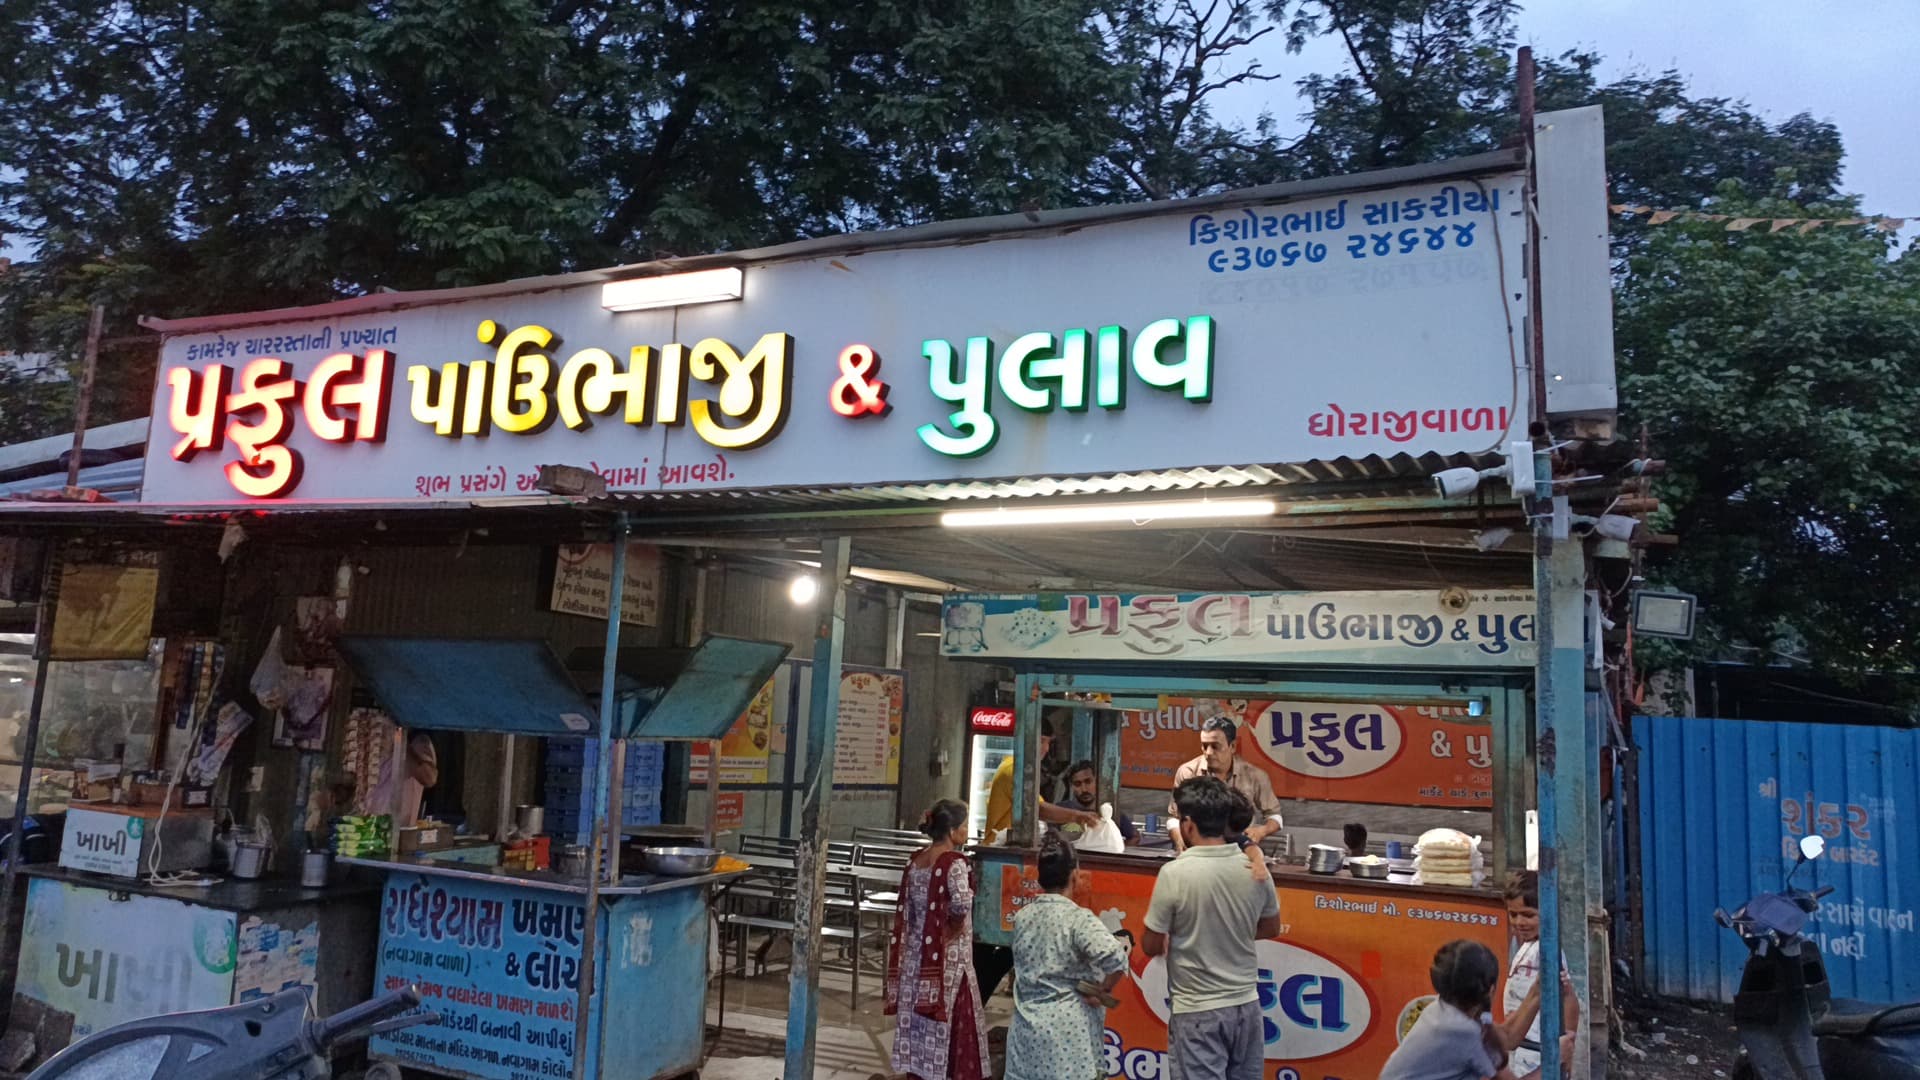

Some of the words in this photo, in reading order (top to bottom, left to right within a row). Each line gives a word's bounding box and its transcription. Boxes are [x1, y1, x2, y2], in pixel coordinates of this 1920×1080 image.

[1189, 199, 1349, 246] કિશોરભાઈ
[1362, 186, 1500, 227] સાકરીયા
[1207, 240, 1328, 274] ૯૩૭૬૭
[1346, 221, 1477, 259] ૨૪૬૪૪
[186, 334, 240, 361] કામરેજ
[340, 325, 398, 350] પ્રખ્યાત
[166, 346, 395, 500] પ્રફુલ
[829, 343, 894, 419] &
[916, 315, 1216, 459] પુલાવ
[460, 465, 507, 494] પ્રસંગે
[1266, 602, 1444, 648] પાઉભાજી
[1450, 618, 1470, 642] &
[972, 710, 1012, 727] Coca-Cola
[1270, 711, 1386, 767] પ્રફુલ
[1430, 729, 1452, 758] &
[76, 830, 127, 856] ખાખી
[1382, 901, 1401, 917] મો.
[505, 951, 521, 978] &
